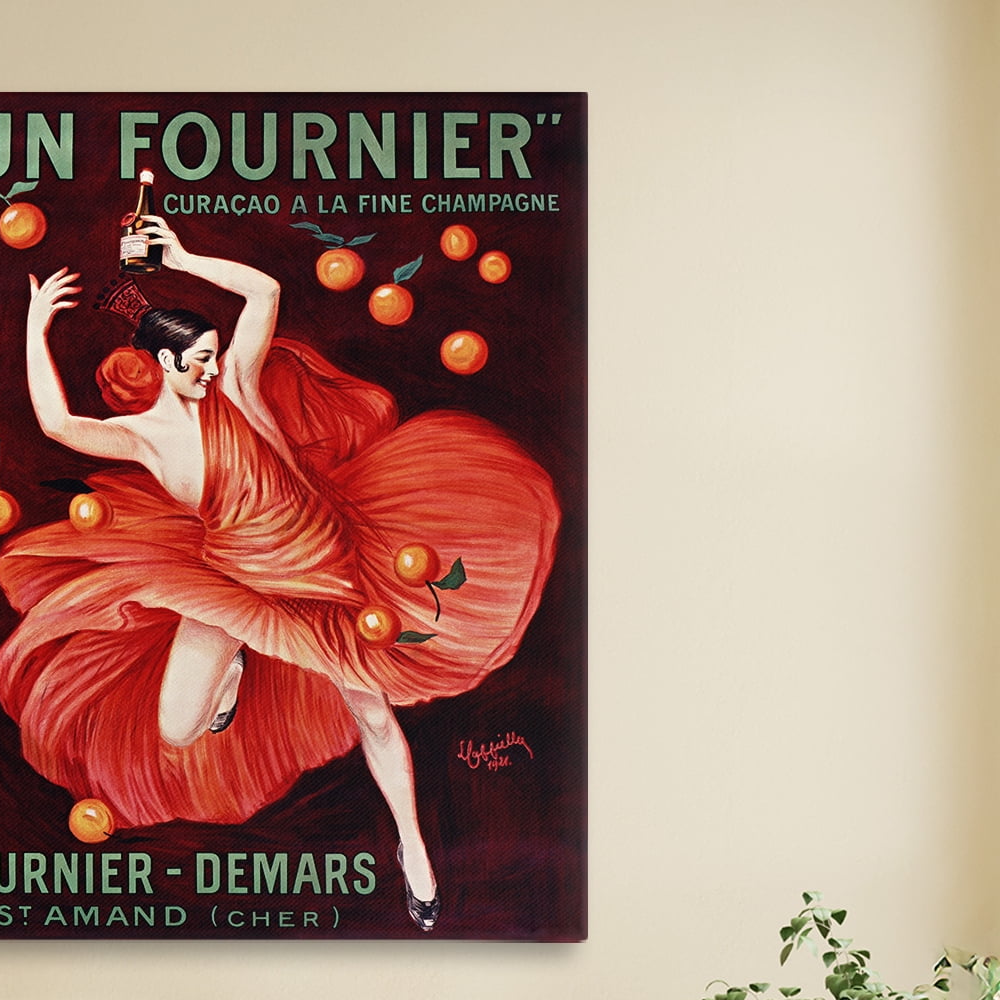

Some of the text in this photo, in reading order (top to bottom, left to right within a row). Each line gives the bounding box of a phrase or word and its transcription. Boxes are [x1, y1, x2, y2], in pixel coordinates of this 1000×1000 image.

[120, 111, 562, 181] FOURNIER"
[163, 192, 560, 217] CURAÇAO A LA FINE CHAMPAGNE
[166, 867, 182, 876] -
[196, 852, 377, 895] DEMARS
[44, 905, 188, 927] AMAND
